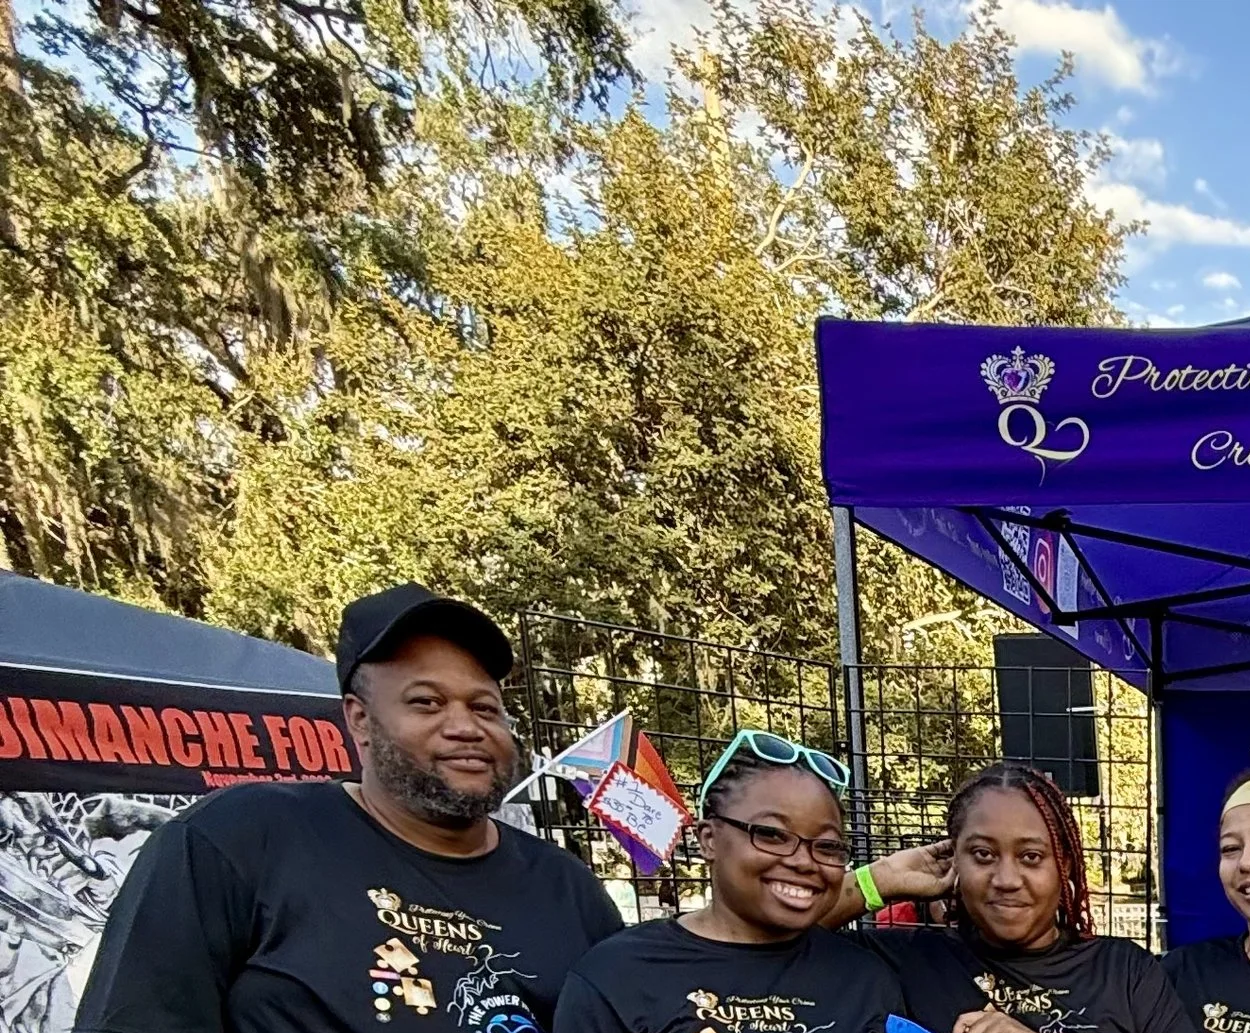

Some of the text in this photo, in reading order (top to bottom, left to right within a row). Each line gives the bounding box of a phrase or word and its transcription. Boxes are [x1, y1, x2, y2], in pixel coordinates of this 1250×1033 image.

[263, 715, 352, 773] FOR
[377, 909, 482, 941] QUEENS
[412, 934, 474, 956] of Heart
[468, 995, 520, 1026] THE POWER
[750, 1020, 791, 1033] Heart
